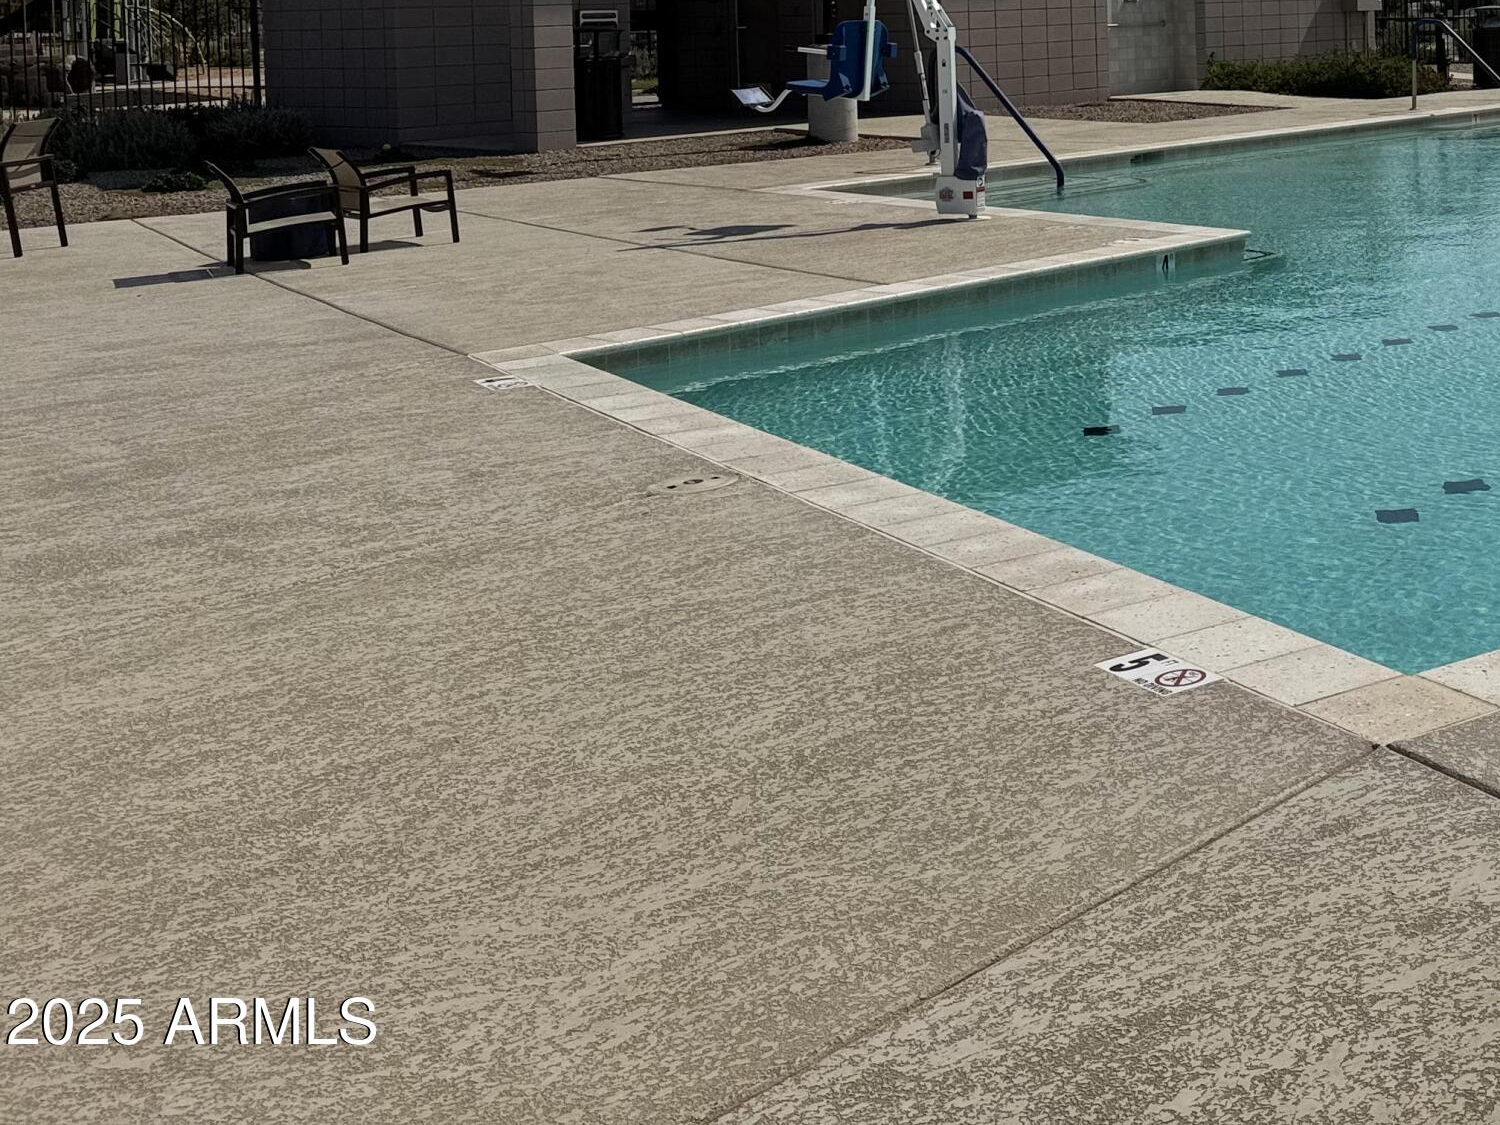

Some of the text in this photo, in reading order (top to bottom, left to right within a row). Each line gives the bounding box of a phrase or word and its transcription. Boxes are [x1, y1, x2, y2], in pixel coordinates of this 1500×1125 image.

[1109, 653, 1169, 672] 5
[1133, 677, 1173, 695] NO DIVING
